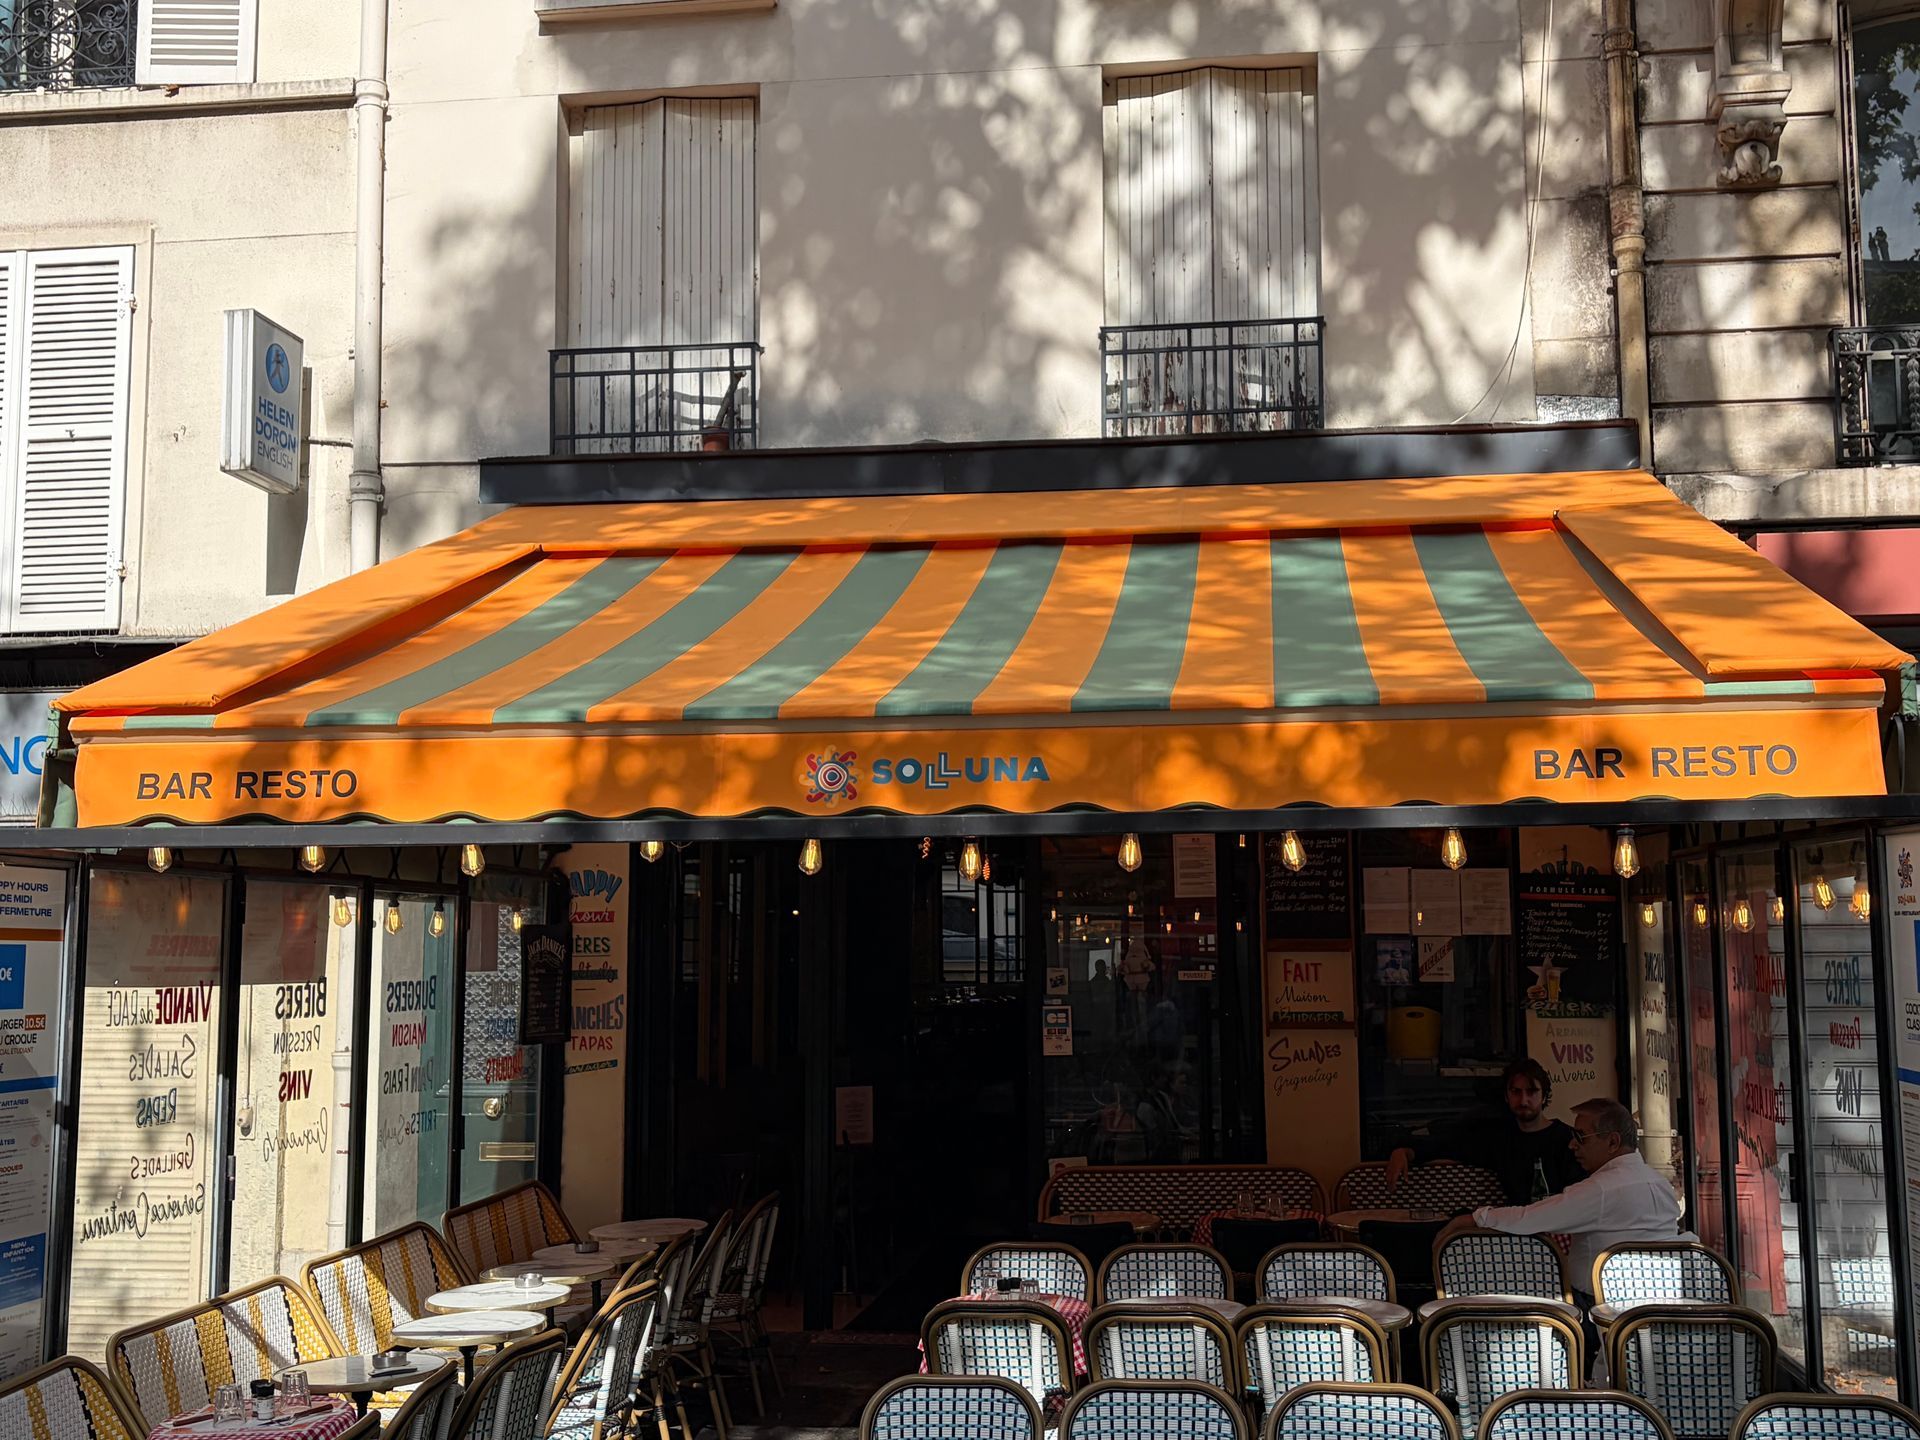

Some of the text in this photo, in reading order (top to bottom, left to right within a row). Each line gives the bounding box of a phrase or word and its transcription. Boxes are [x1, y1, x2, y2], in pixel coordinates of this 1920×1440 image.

[258, 396, 294, 431] HELEN
[255, 416, 296, 453] DORON
[257, 441, 294, 472] ENGLISH
[871, 752, 1050, 789] SOLLUNA
[1534, 744, 1798, 780] BAR RESTO
[137, 769, 357, 800] BAR RESTO
[17, 882, 49, 892] HOURS
[568, 869, 622, 903] APPY
[1529, 885, 1607, 895] FORMULE STAR
[0, 907, 52, 917] FERMETURE
[14, 895, 33, 904] MIDI
[1423, 942, 1434, 953] IV
[1283, 958, 1323, 984] FAIT
[1275, 985, 1331, 1004] Maison
[25, 1017, 46, 1030] 10.5€
[570, 994, 624, 1030] ANCHES
[5, 1033, 37, 1046] CROQUE
[571, 1035, 613, 1051] TAPAS
[1268, 1036, 1342, 1072] SALADES
[1550, 1042, 1594, 1065] VINS
[1273, 1067, 1338, 1096] Grignotage
